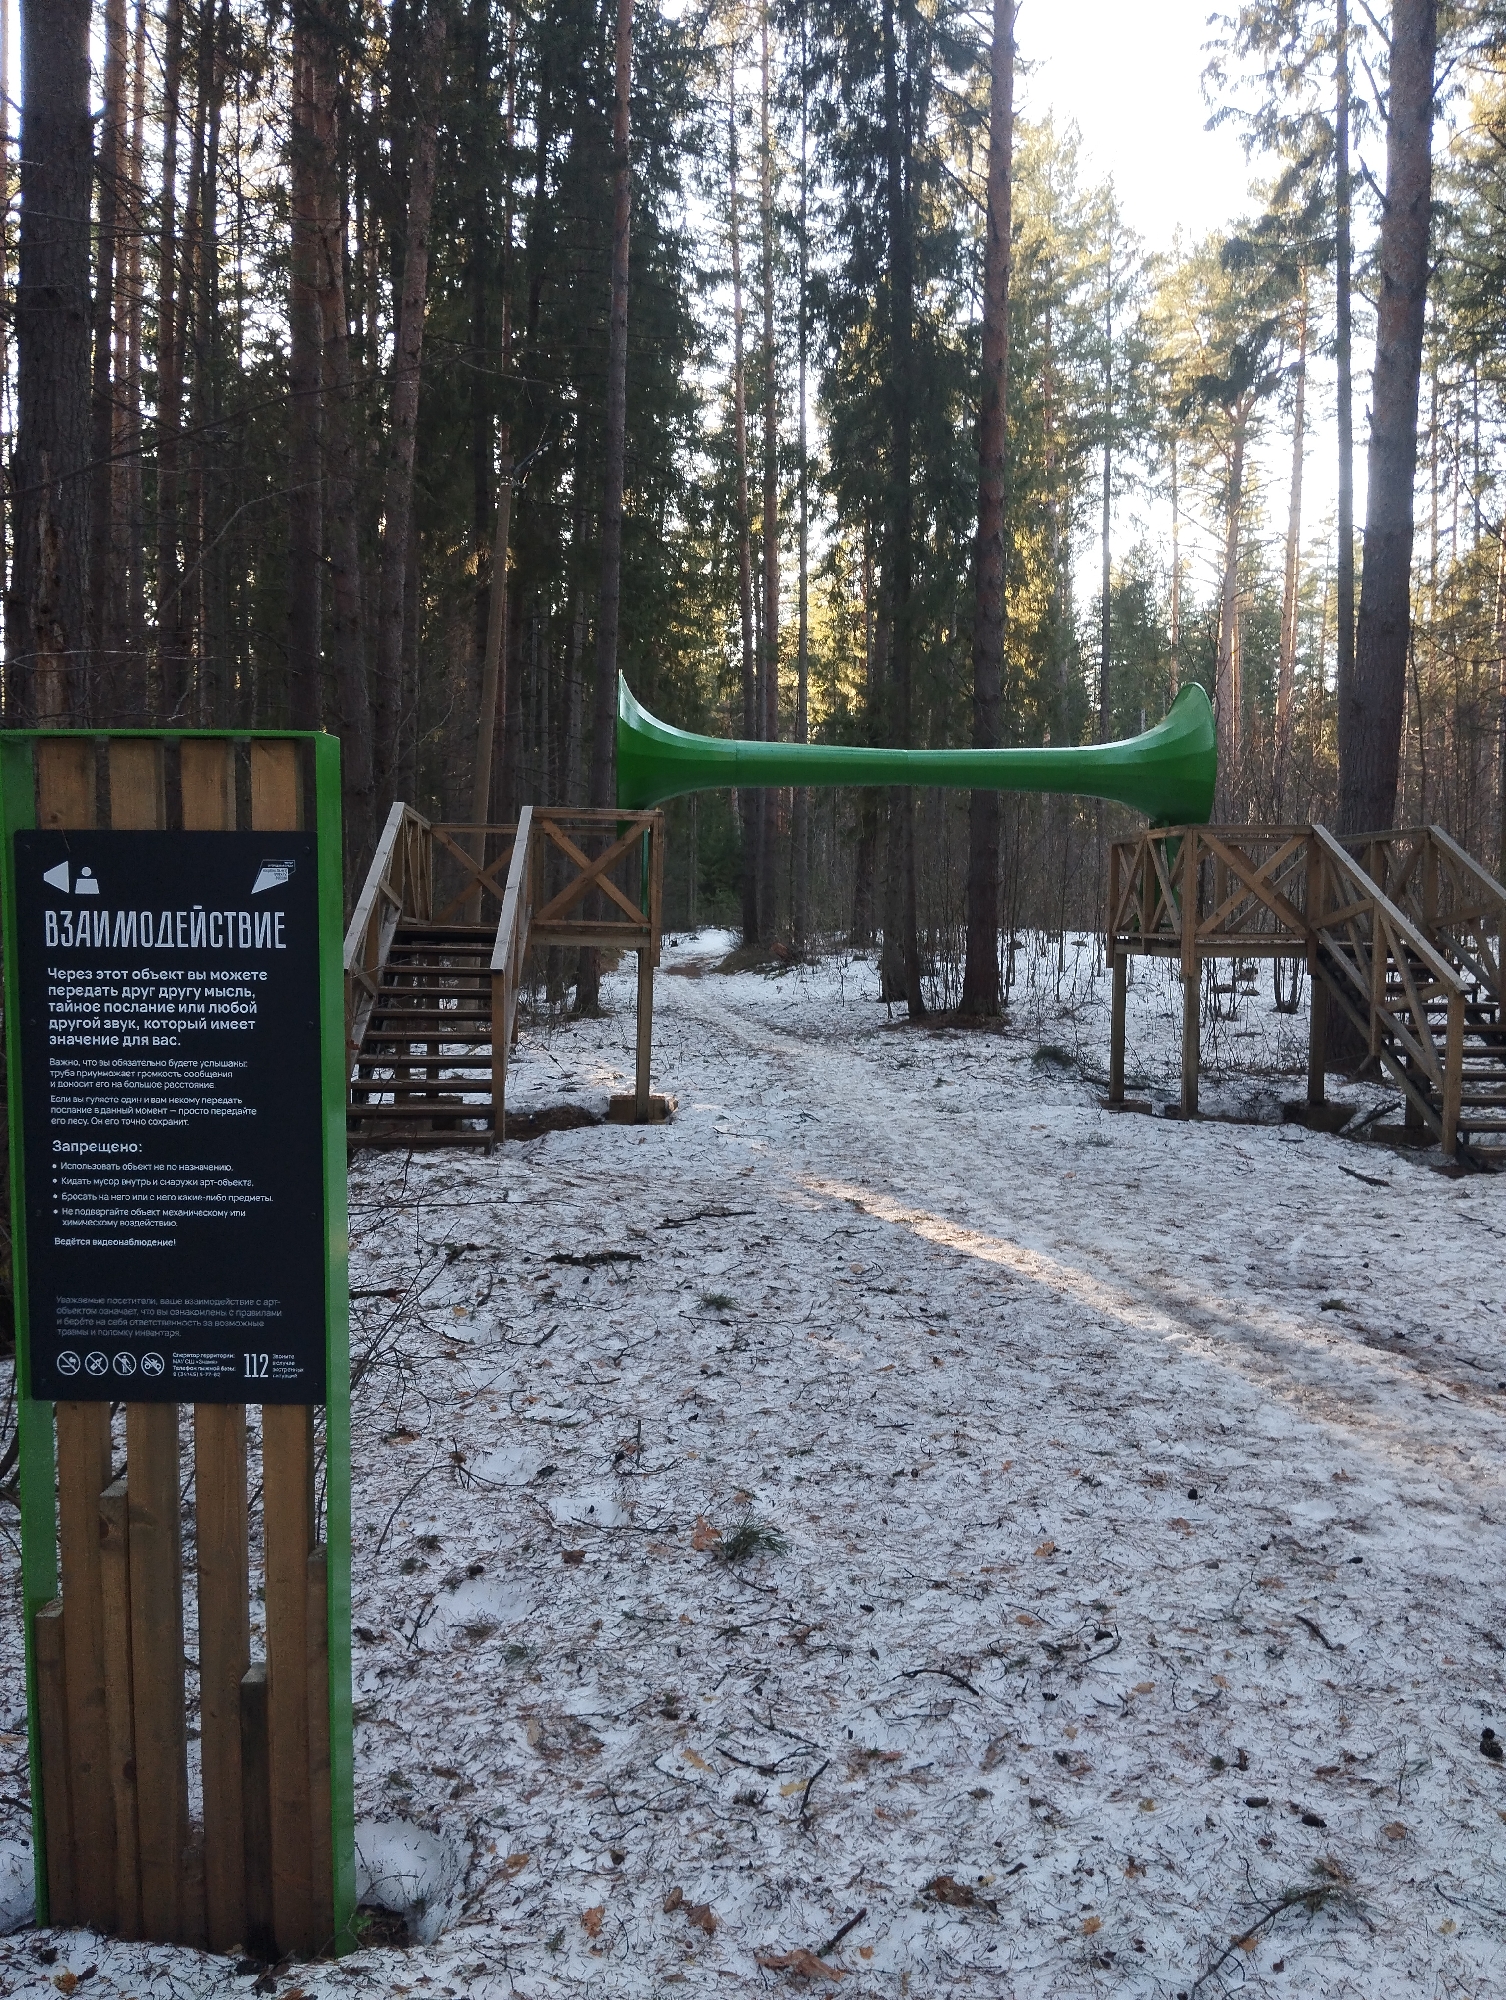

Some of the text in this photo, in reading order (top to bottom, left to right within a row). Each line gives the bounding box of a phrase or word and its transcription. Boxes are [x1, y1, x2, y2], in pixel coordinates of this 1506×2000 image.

[45, 904, 287, 949] ВЗАИМОДЕЙСТВИЕ
[48, 968, 268, 982] Через этот объект вы можете
[48, 985, 255, 1000] передать друг другу мысль,
[48, 1000, 257, 1014] тайное послание или любой
[49, 1017, 255, 1032] другой звук, который имеет
[49, 1034, 181, 1048] значение для вас.
[49, 1057, 81, 1067] Важно,
[83, 1059, 97, 1067] что
[99, 1059, 110, 1067] вы
[112, 1058, 166, 1067] обязательно
[168, 1058, 198, 1069] будете
[50, 1069, 233, 1079] труба приумножает громкость сообщения
[124, 1080, 162, 1089] большое
[50, 1095, 71, 1103] Если
[100, 1106, 133, 1114] данный
[179, 1108, 209, 1116] просто
[211, 1107, 257, 1116] передайте
[67, 1118, 89, 1126] лесу.
[91, 1116, 102, 1125] Он
[148, 1119, 189, 1127] сохранит.
[52, 1139, 142, 1155] Запрещено:
[60, 1162, 120, 1171] Использовать
[122, 1162, 152, 1171] объект
[61, 1177, 91, 1185] Кидать
[94, 1179, 119, 1187] мусор
[122, 1179, 151, 1187] внутрь
[160, 1179, 198, 1187] снаружи
[61, 1192, 97, 1201] Бросать
[228, 1195, 273, 1203] предметы.
[62, 1207, 73, 1215] Не
[75, 1207, 128, 1217] подвергайте
[131, 1208, 160, 1216] объект
[163, 1209, 228, 1218] механическому
[62, 1219, 178, 1228] химическому воздействию.
[54, 1237, 176, 1247] Ведётся видеонаблюдение!
[244, 1353, 269, 1378] 112
